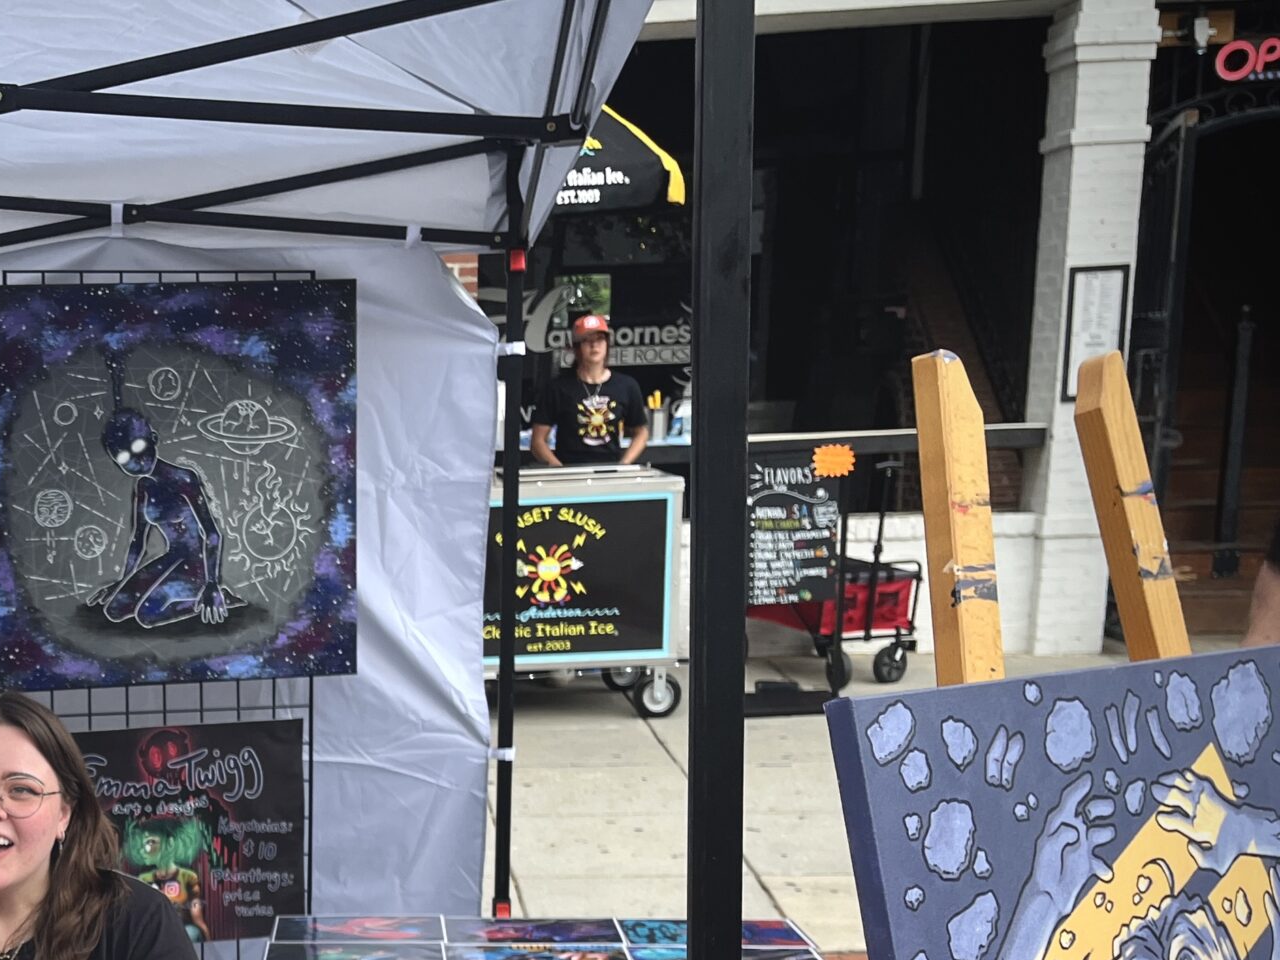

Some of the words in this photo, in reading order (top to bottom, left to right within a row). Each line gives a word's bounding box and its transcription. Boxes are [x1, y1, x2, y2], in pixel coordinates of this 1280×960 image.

[764, 467, 813, 485] FLAVORS
[557, 507, 607, 541] SLUSH
[535, 622, 585, 638] Italian
[588, 620, 615, 635] Ice
[167, 745, 264, 802] Twigg
